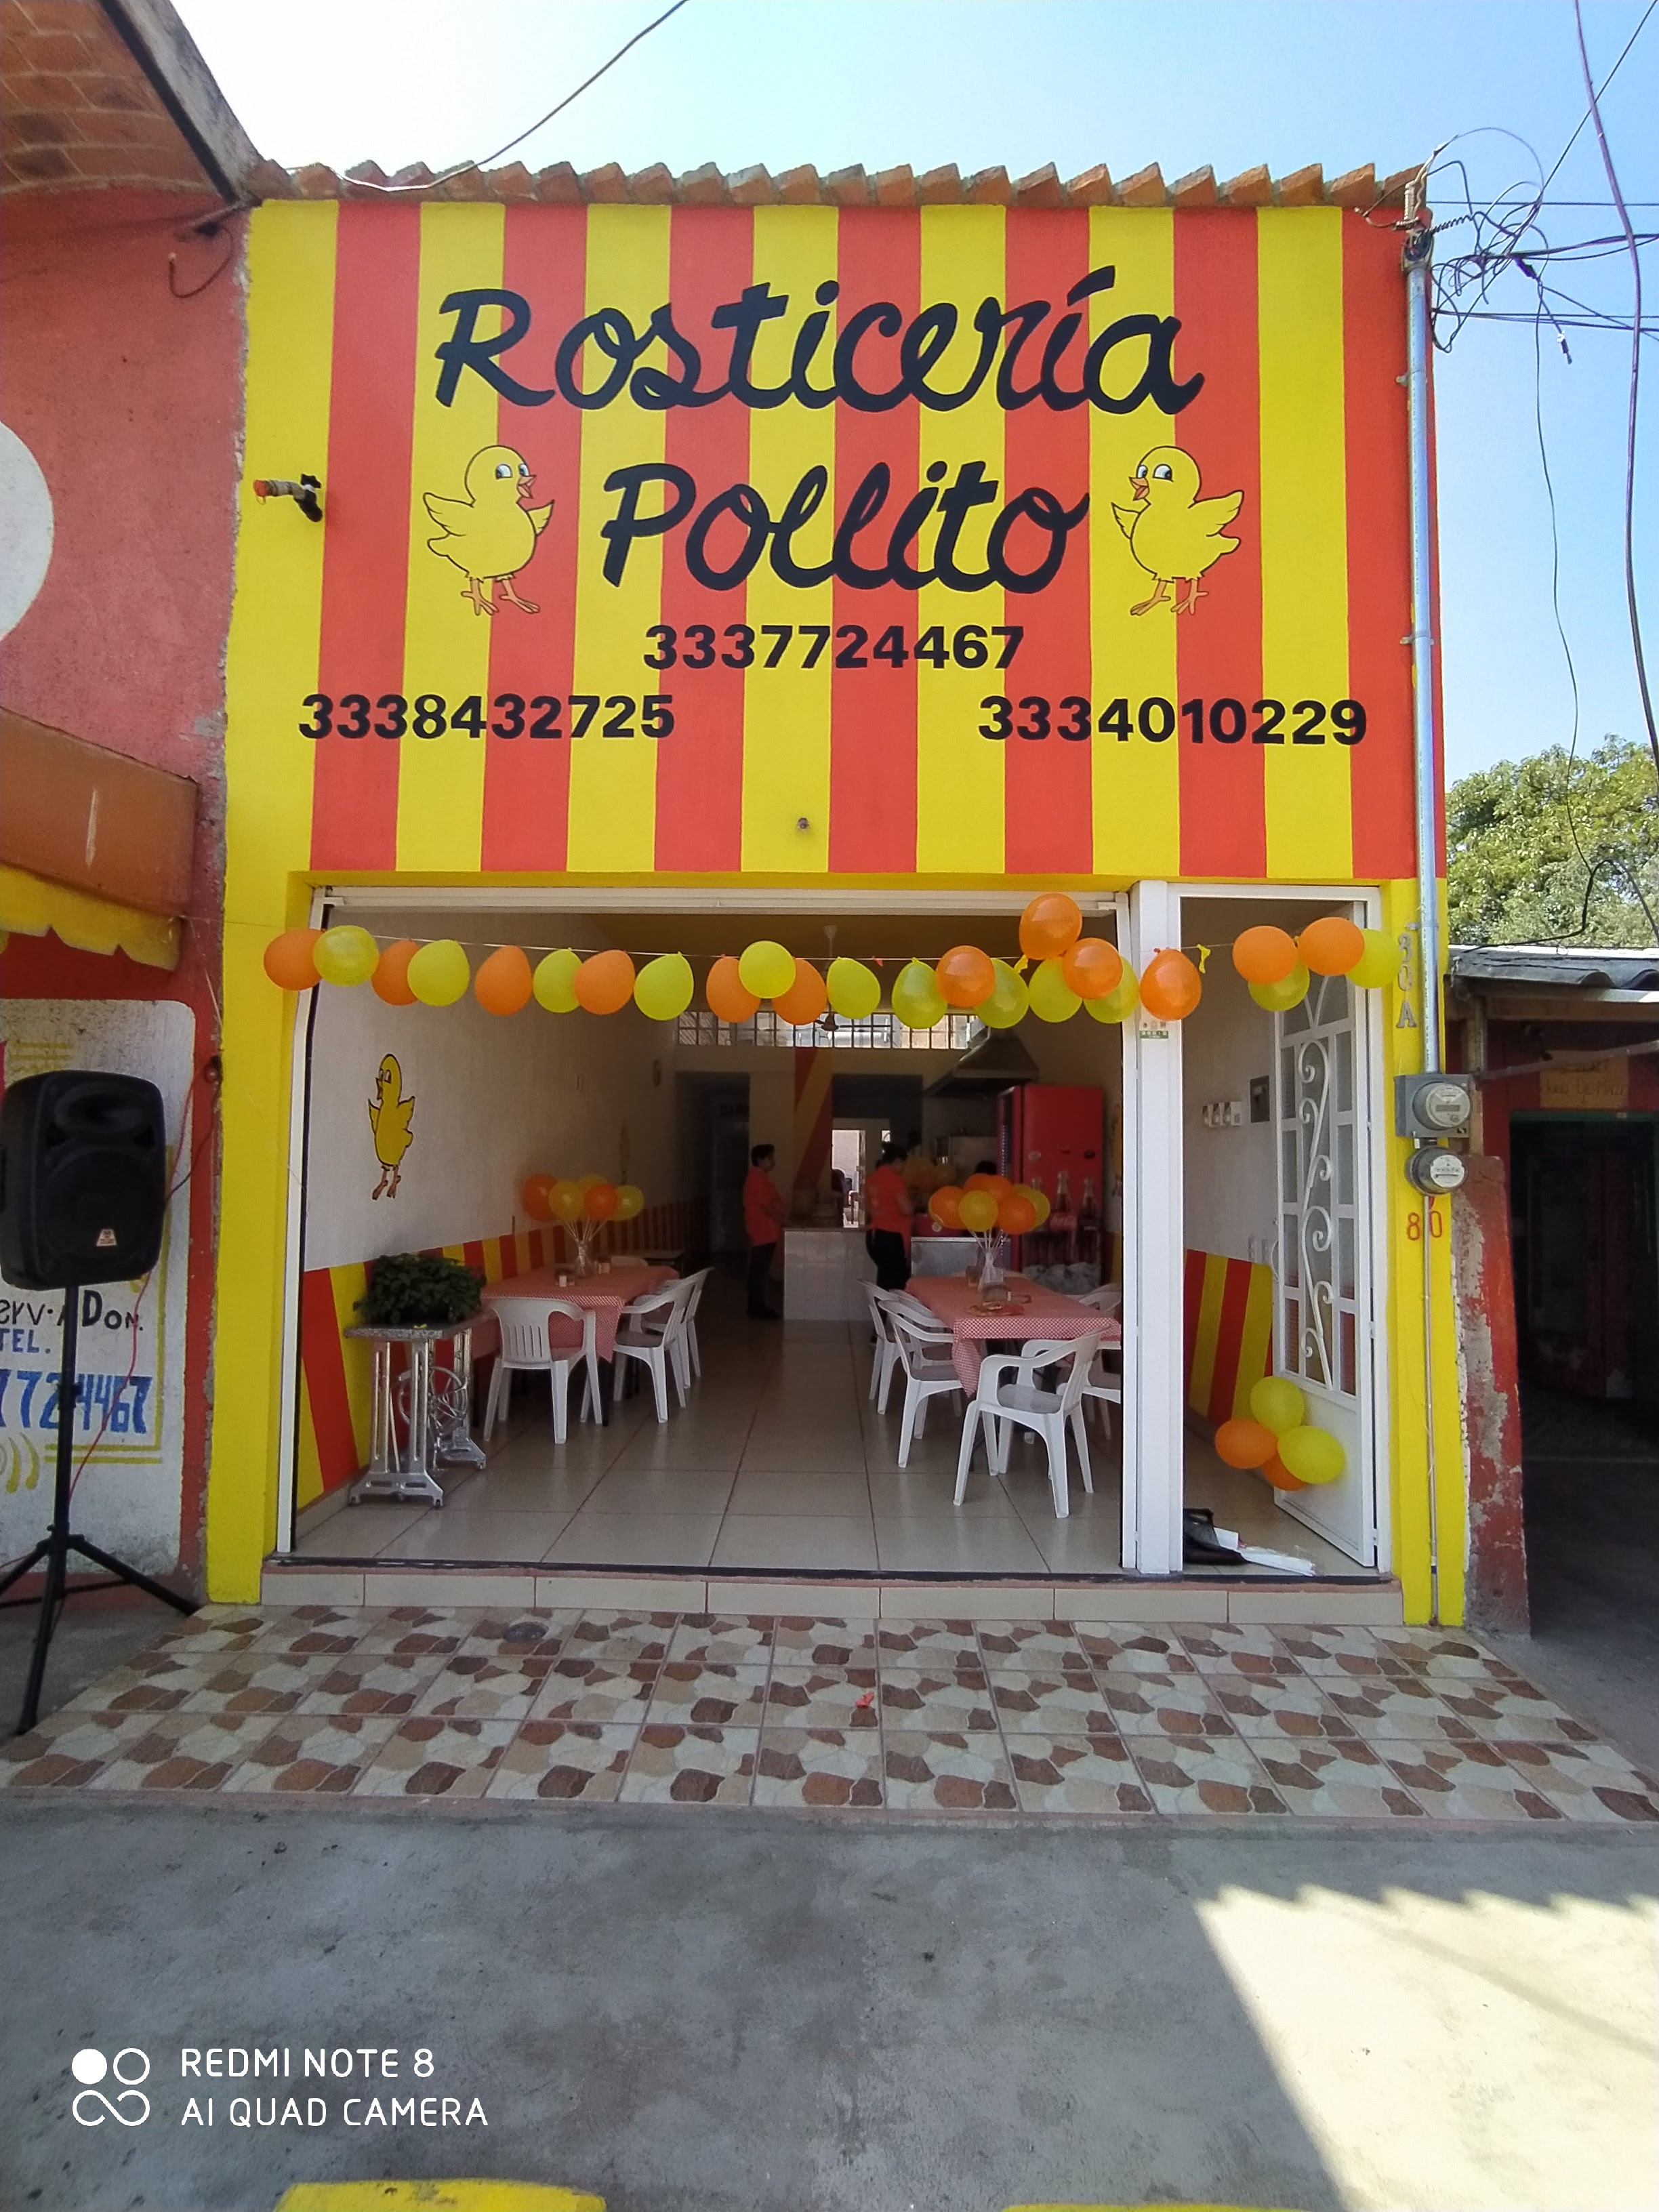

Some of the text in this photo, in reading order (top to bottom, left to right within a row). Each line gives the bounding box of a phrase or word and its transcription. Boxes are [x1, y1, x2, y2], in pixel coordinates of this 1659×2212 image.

[435, 265, 1204, 415] Rosticería
[600, 460, 1090, 594] Pollito
[644, 624, 1024, 670] 3337724467
[299, 693, 674, 739] 3338432725
[979, 695, 1366, 745] 3334010229
